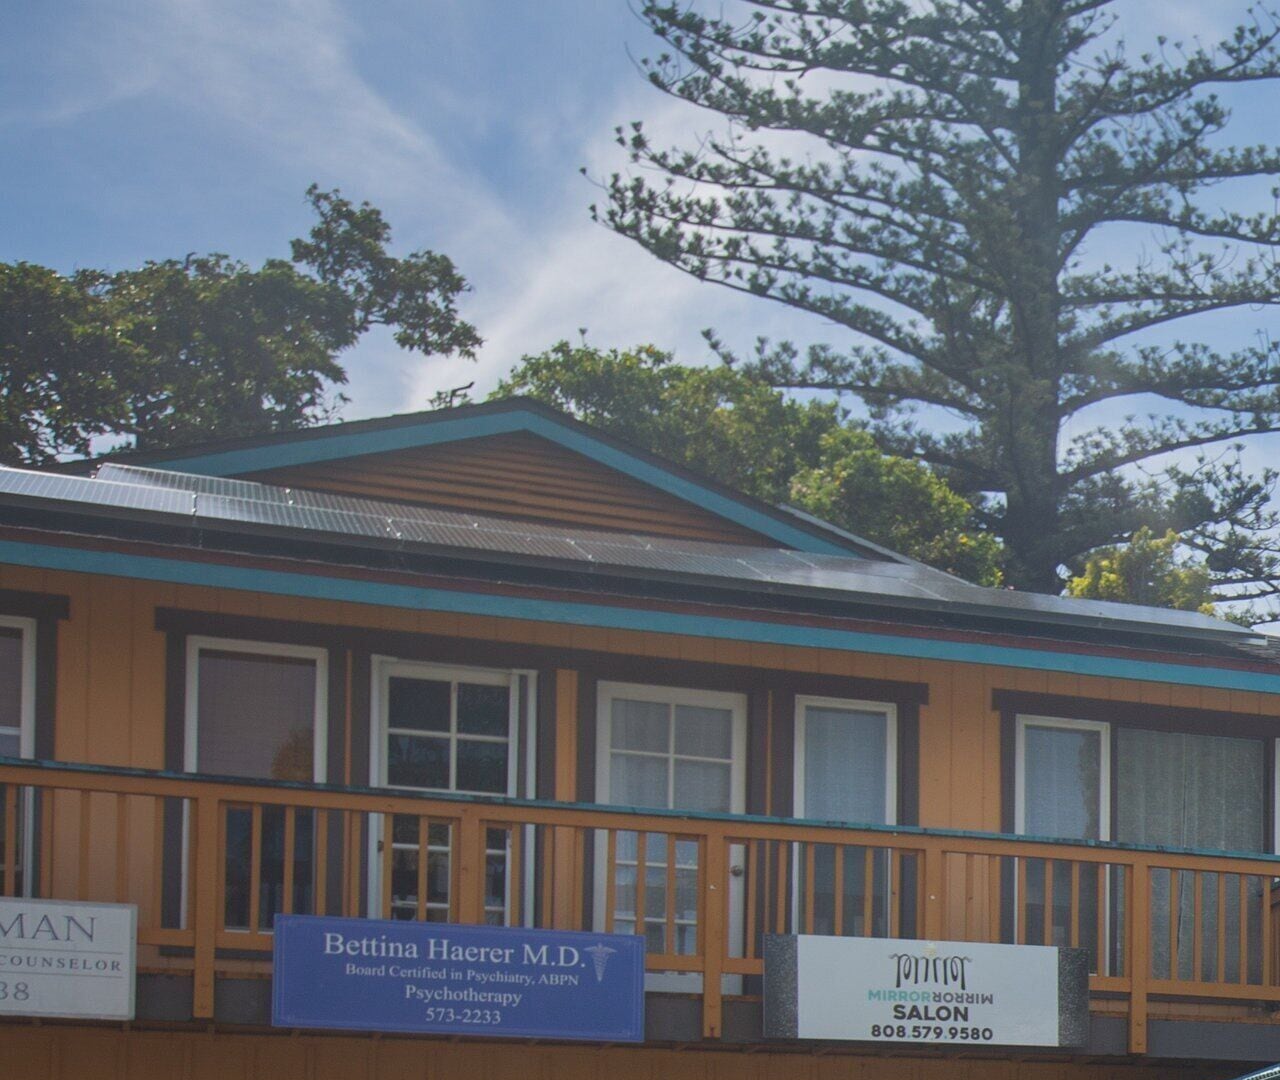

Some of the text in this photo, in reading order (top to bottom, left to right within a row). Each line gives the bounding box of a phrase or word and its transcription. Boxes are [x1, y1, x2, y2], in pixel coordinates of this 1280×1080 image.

[324, 932, 586, 968] Bettina Haerer M.D.
[345, 963, 580, 986] Board Certified in Psychiatry, ABPN
[405, 984, 522, 1007] Psychotherapy
[868, 989, 931, 1002] MIRROR
[425, 1007, 501, 1024] 573-2233
[893, 1004, 968, 1022] SALON
